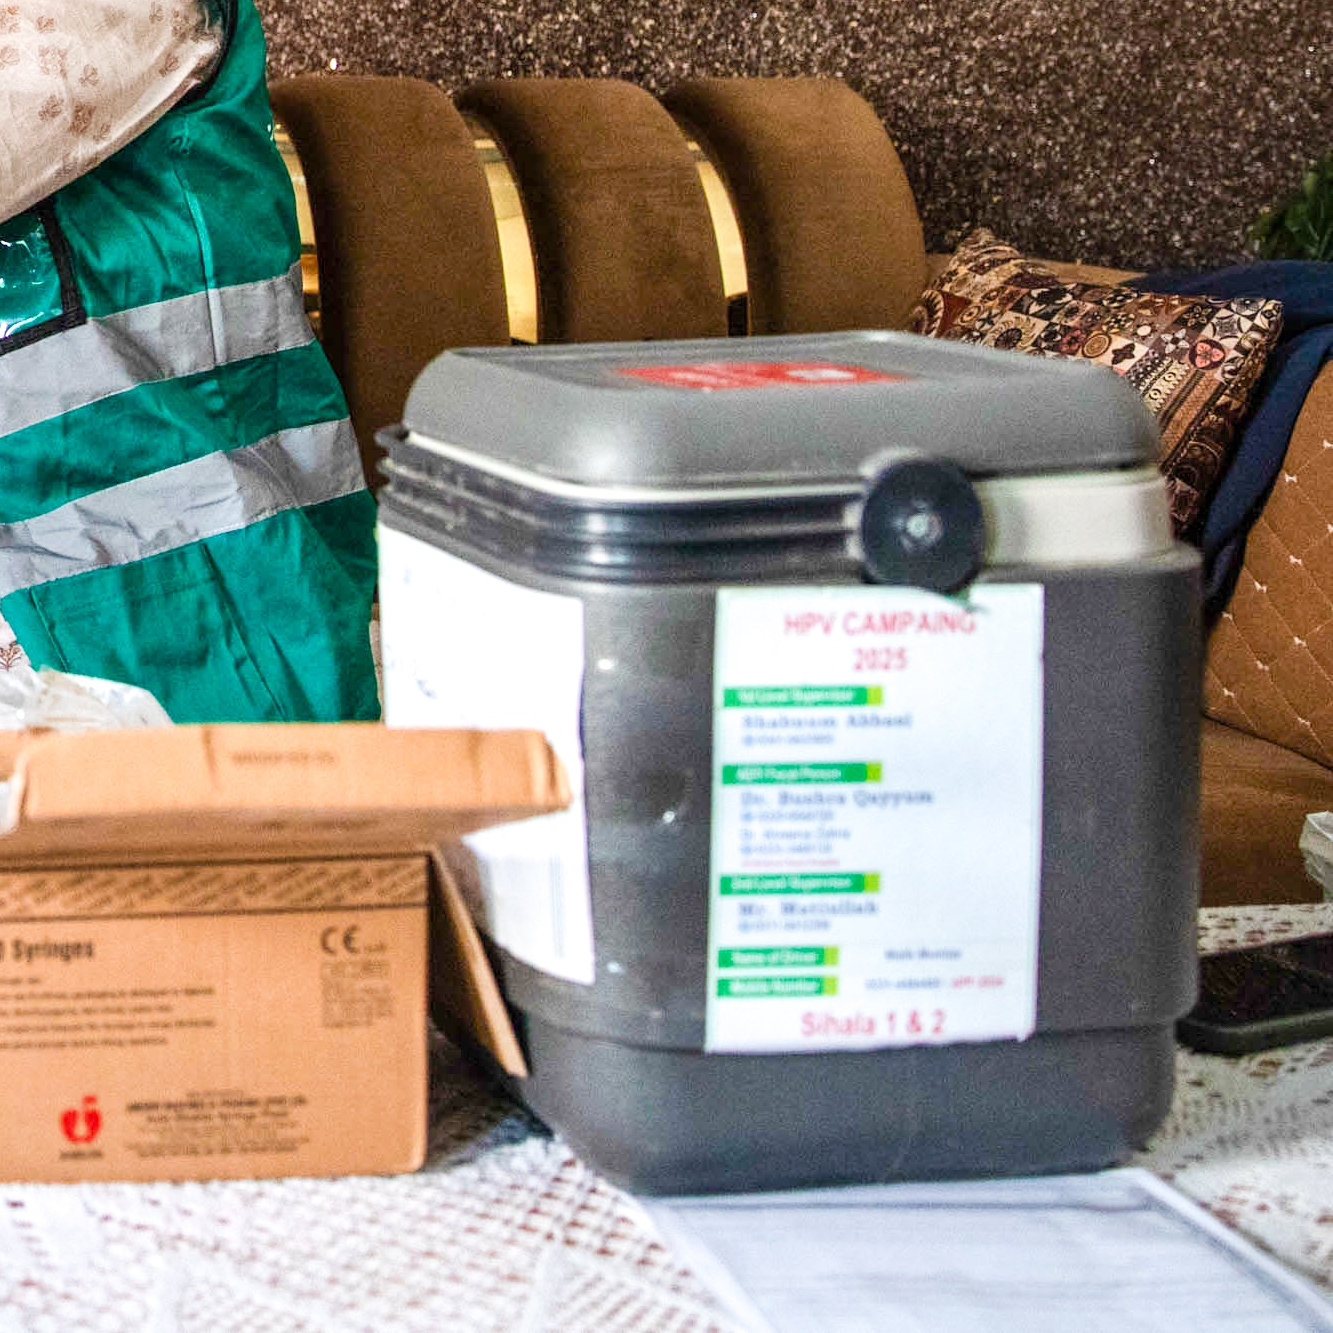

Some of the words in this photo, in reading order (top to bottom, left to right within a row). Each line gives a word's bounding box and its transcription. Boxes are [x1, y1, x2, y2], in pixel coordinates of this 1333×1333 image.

[784, 612, 834, 635] HPV
[842, 611, 976, 635] CAMPAING
[854, 647, 908, 671] 2025
[11, 937, 94, 963] Syringes
[802, 1012, 876, 1037] Sihala
[887, 1012, 896, 1035] 1
[906, 1010, 922, 1035] &
[932, 1009, 946, 1035] 2
